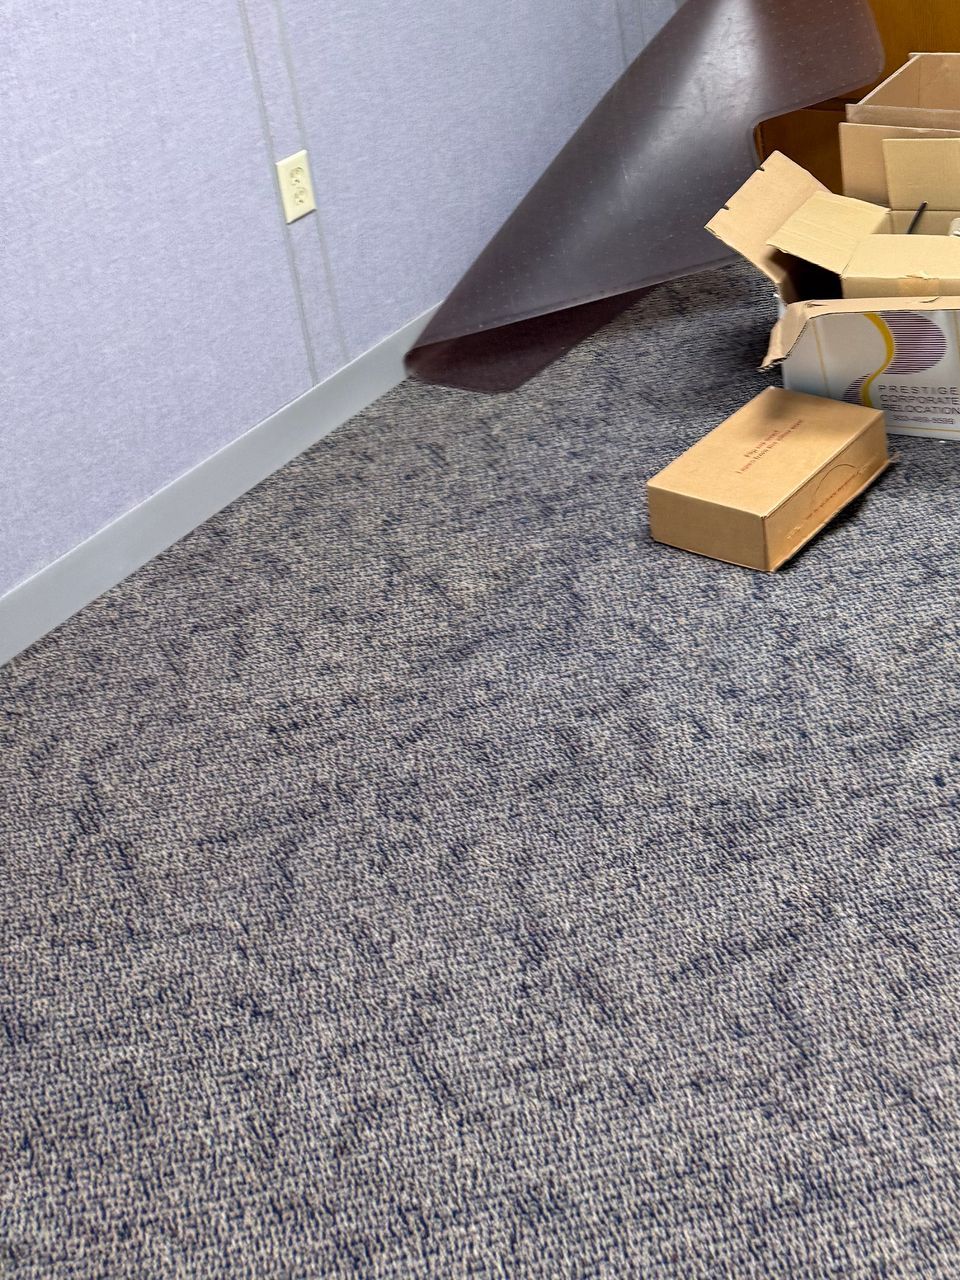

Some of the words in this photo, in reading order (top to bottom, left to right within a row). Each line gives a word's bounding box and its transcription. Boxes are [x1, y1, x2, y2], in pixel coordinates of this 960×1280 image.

[878, 384, 960, 395] PRESTIGE
[879, 394, 960, 405] CORPORATE
[881, 403, 960, 414] RELOCATION
